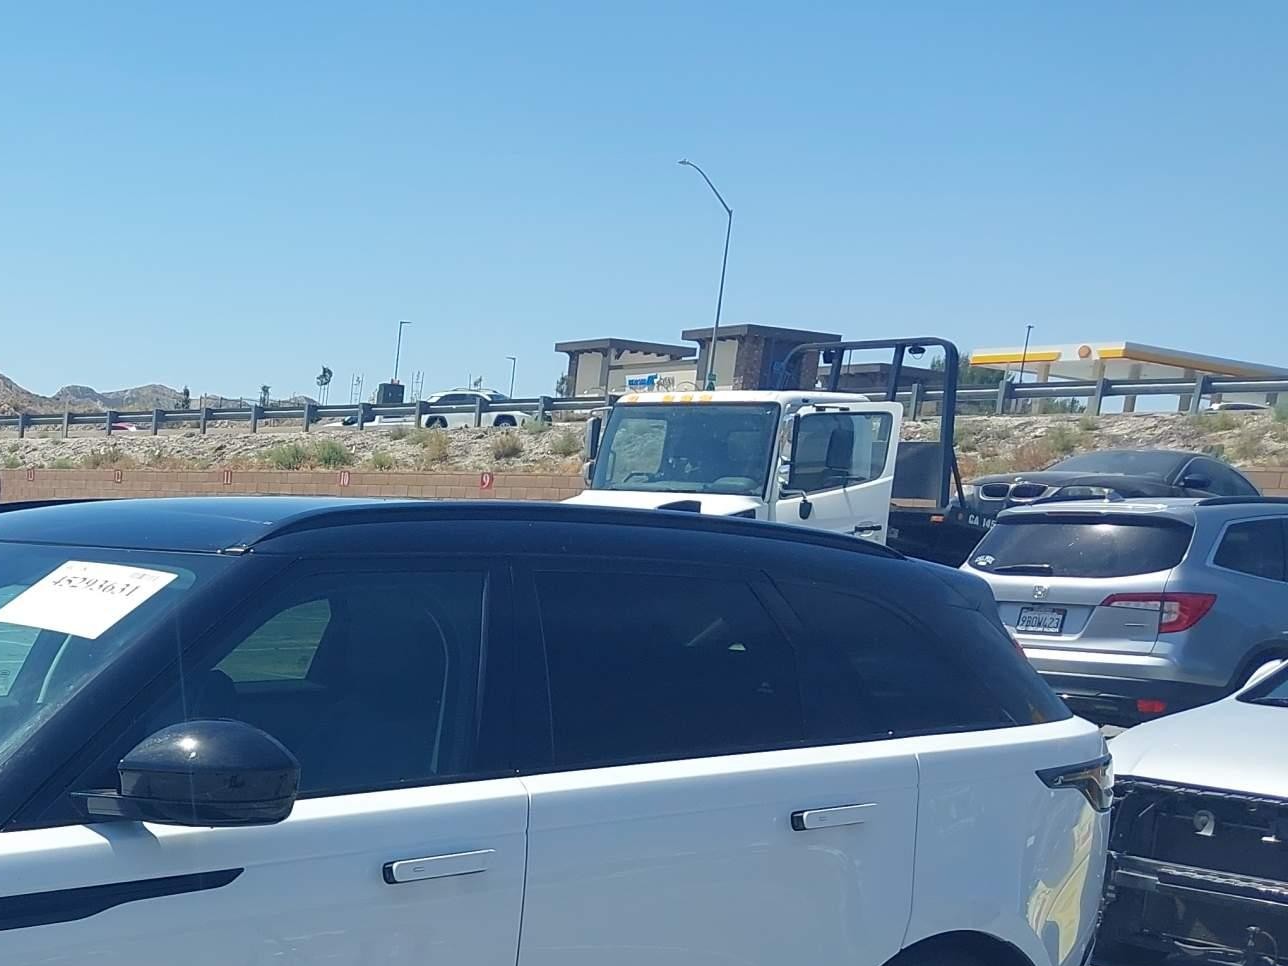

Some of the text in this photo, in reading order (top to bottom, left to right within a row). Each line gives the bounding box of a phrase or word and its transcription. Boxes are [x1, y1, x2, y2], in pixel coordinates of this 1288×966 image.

[340, 471, 349, 486] 10
[482, 473, 490, 489] 9
[52, 575, 142, 598] 45293631
